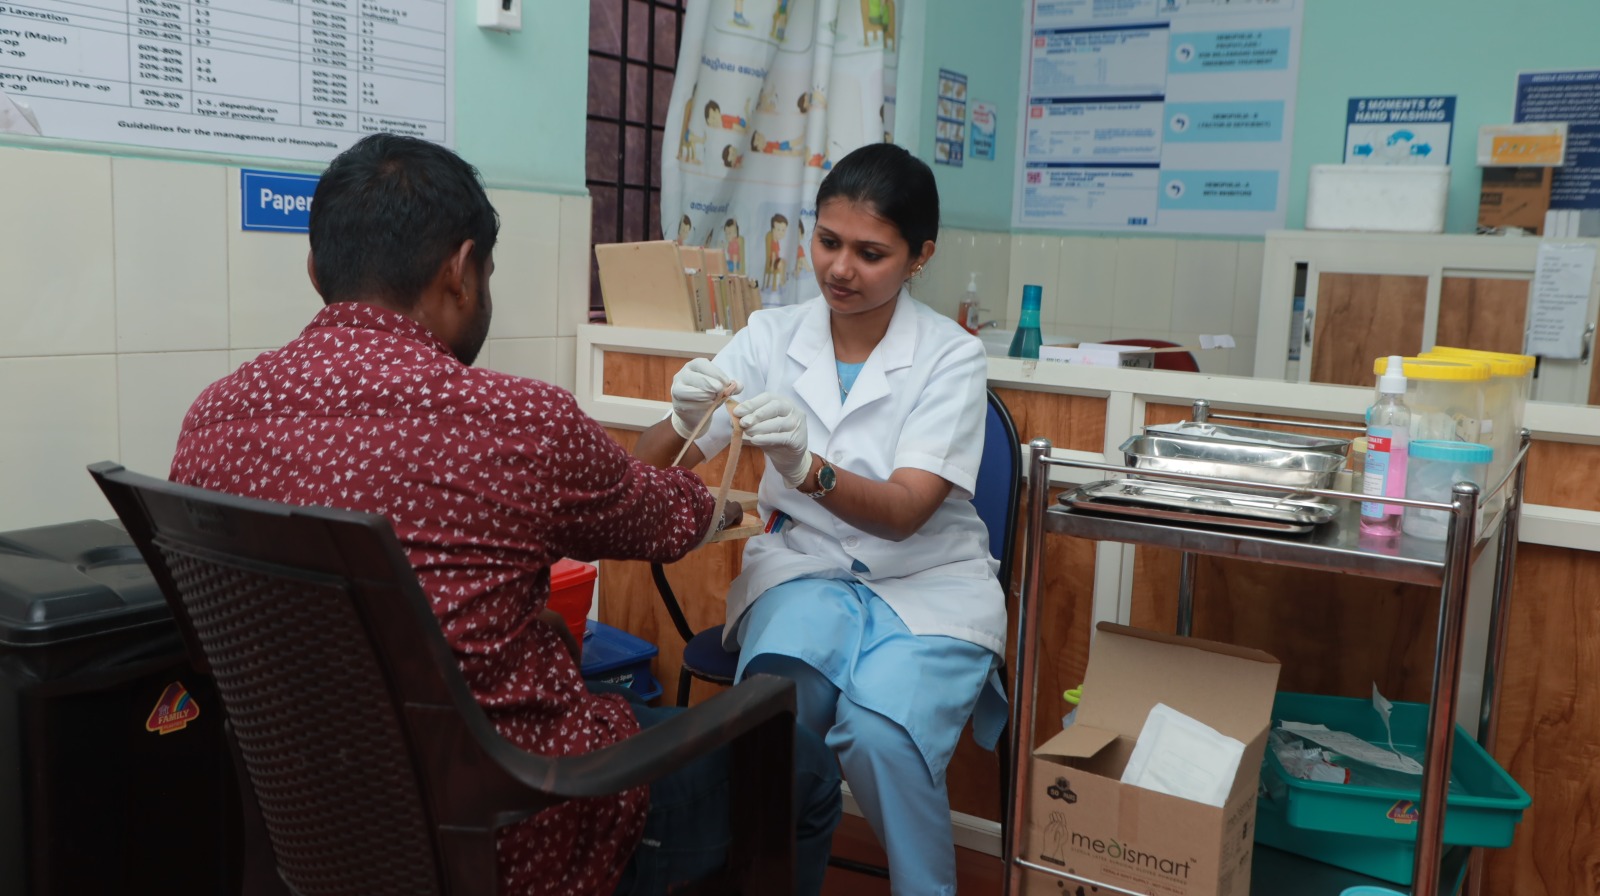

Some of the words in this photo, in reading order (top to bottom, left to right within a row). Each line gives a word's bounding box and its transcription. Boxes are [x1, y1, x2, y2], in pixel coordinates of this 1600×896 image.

[9, 7, 69, 22] Laceration
[25, 31, 67, 44] (Major)
[6, 49, 25, 57] -op
[8, 84, 27, 92] -op
[27, 75, 69, 87] (Minor)
[72, 80, 90, 88] Pre
[219, 102, 265, 114] depending
[1367, 98, 1426, 110] MOMENTS
[1427, 97, 1445, 109] OF
[197, 108, 217, 116] type
[231, 111, 276, 122] procedure
[1355, 110, 1388, 122] HAND
[1389, 109, 1446, 121] WASHING
[379, 119, 416, 129] depending
[118, 120, 174, 133] Guidelines
[177, 126, 192, 135] for
[194, 128, 211, 136] the
[213, 131, 276, 143] management
[289, 138, 338, 148] Hemophilia
[390, 128, 424, 136] procedure
[260, 187, 313, 215] Paper
[158, 709, 190, 724] FAMILY
